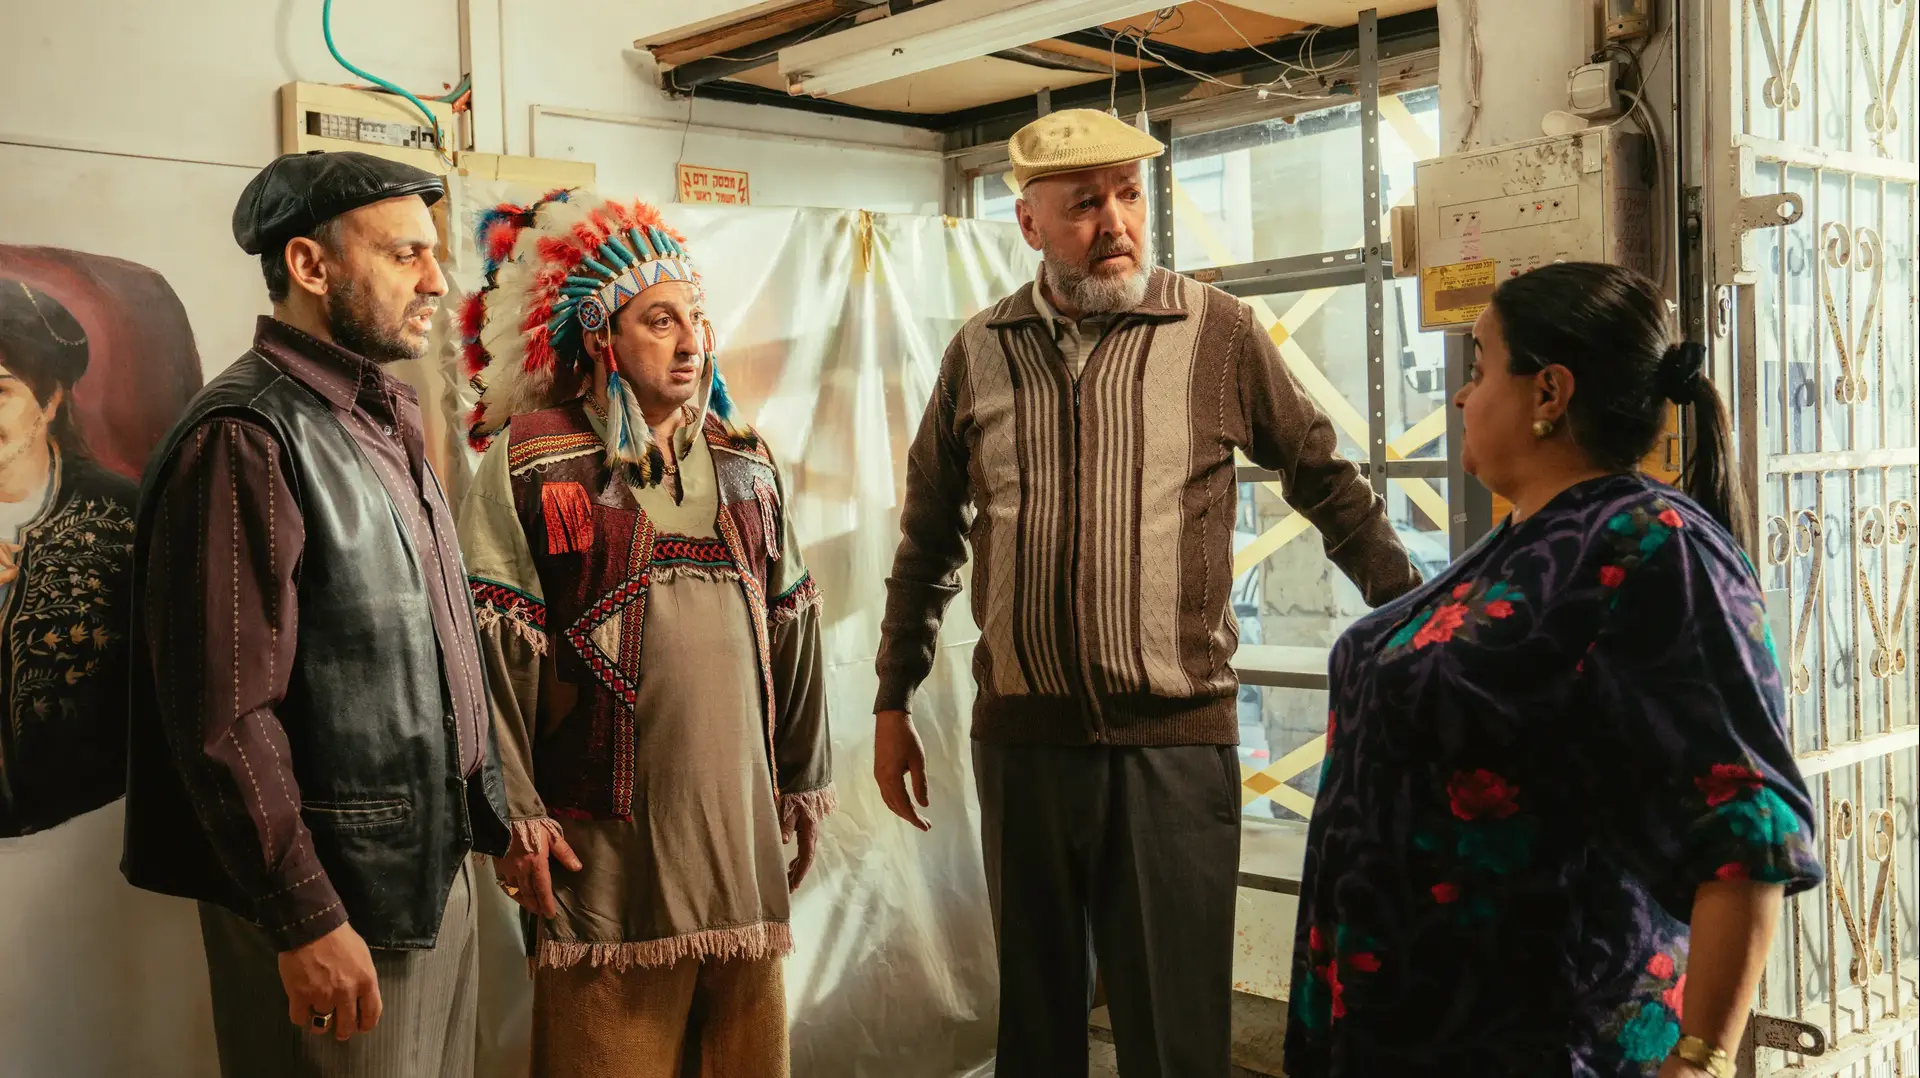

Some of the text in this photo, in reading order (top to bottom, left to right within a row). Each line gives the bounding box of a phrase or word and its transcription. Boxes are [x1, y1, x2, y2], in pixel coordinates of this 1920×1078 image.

[693, 172, 736, 190] מפסק זרם
[693, 190, 736, 204] חשמל ראשי
